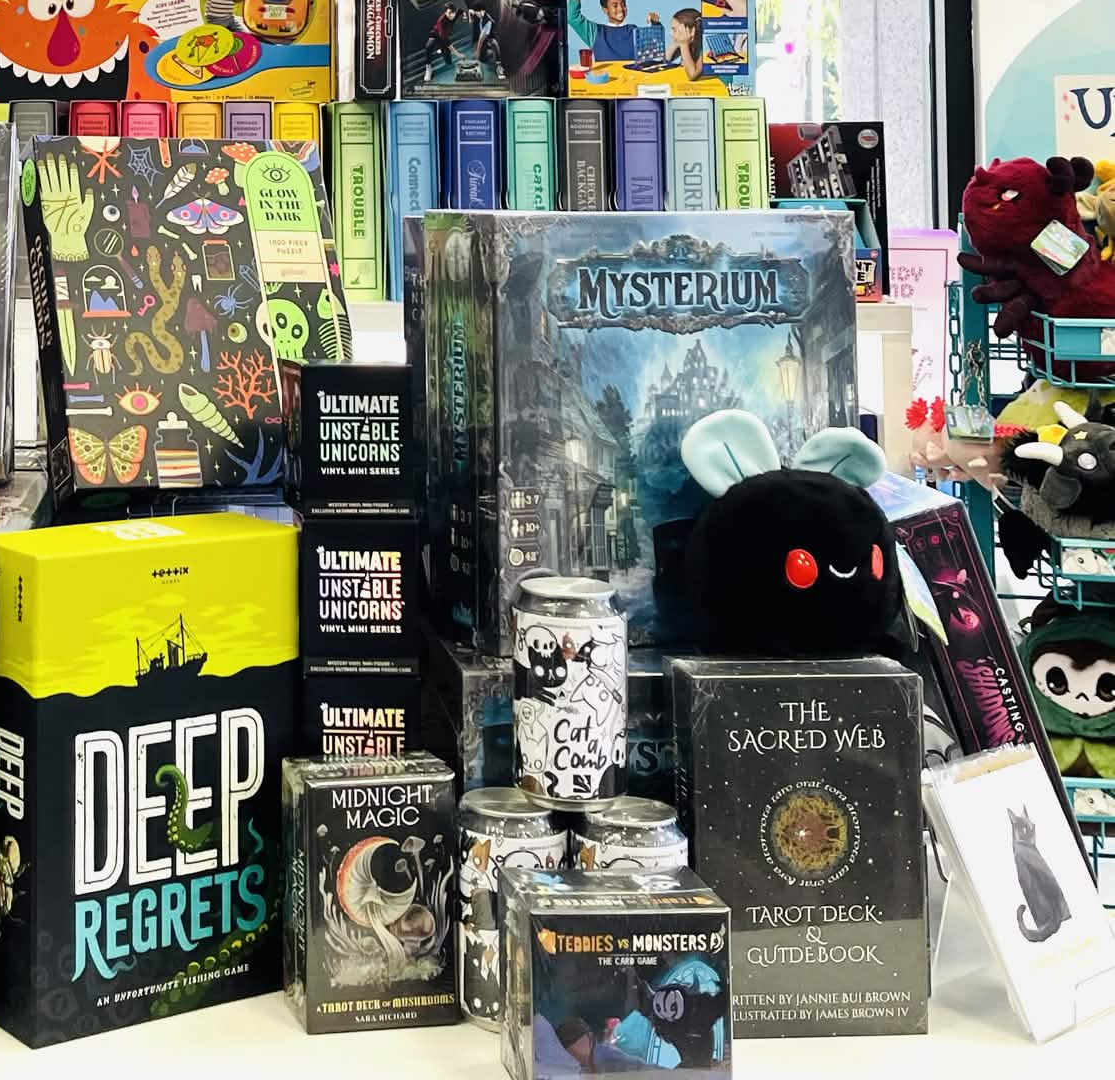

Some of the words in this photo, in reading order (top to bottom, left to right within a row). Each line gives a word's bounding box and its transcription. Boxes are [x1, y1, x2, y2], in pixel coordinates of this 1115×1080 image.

[259, 188, 299, 199] GLOW
[259, 199, 274, 210] IN
[276, 200, 302, 210] THE
[350, 164, 367, 239] TROUBLE
[265, 211, 302, 221] DARK
[577, 266, 782, 320] MYSTERIUM
[316, 391, 400, 414] ULTIMATE
[320, 417, 400, 442] UNSTABLE
[320, 443, 401, 462] UNICORNS
[320, 467, 346, 475] VINYL
[348, 467, 368, 475] MINI
[370, 467, 401, 475] SERIES
[316, 545, 402, 571] ULTIMATE
[320, 573, 402, 599] UNSTABLE
[319, 600, 403, 621] UNICORNS
[320, 624, 346, 634] VINYL
[348, 624, 368, 634] MINI
[370, 624, 402, 634] SERIES
[995, 667, 1025, 732] CASTING
[320, 702, 405, 729] ULTIMATE
[780, 700, 831, 723] THE
[553, 717, 593, 746] Cat
[727, 728, 827, 753] SACRED
[835, 729, 886, 753] WEB
[553, 745, 608, 772] Comb
[73, 707, 265, 896] DEEP
[332, 785, 434, 809] MIDNIGHT
[346, 806, 421, 830] MAGIC
[71, 864, 267, 982] REGRETS
[746, 905, 816, 924] TAROT
[819, 905, 881, 925] DECK
[557, 934, 614, 953] TEDDIES
[633, 934, 707, 953] MONSTERS
[806, 926, 827, 943] &
[598, 957, 612, 966] THE
[615, 957, 635, 966] CARD
[637, 956, 657, 966] GAME
[747, 945, 884, 966] GUIDEBOOK
[97, 995, 111, 1007] AN
[113, 980, 180, 1005] UNFORTUNATE
[182, 972, 222, 988] FISHING
[224, 963, 250, 979] GAME
[322, 1000, 354, 1014] TAROT
[356, 999, 381, 1011] DECK
[778, 993, 791, 1005] BY
[796, 992, 839, 1007] JANNIE
[865, 991, 911, 1003] BROWN
[355, 1013, 376, 1023] SARA
[378, 1011, 418, 1022] RICHARD
[800, 1008, 813, 1020] BY
[816, 1008, 849, 1022] JAMES
[852, 1007, 895, 1019] BROWN
[897, 1007, 910, 1017] IV
